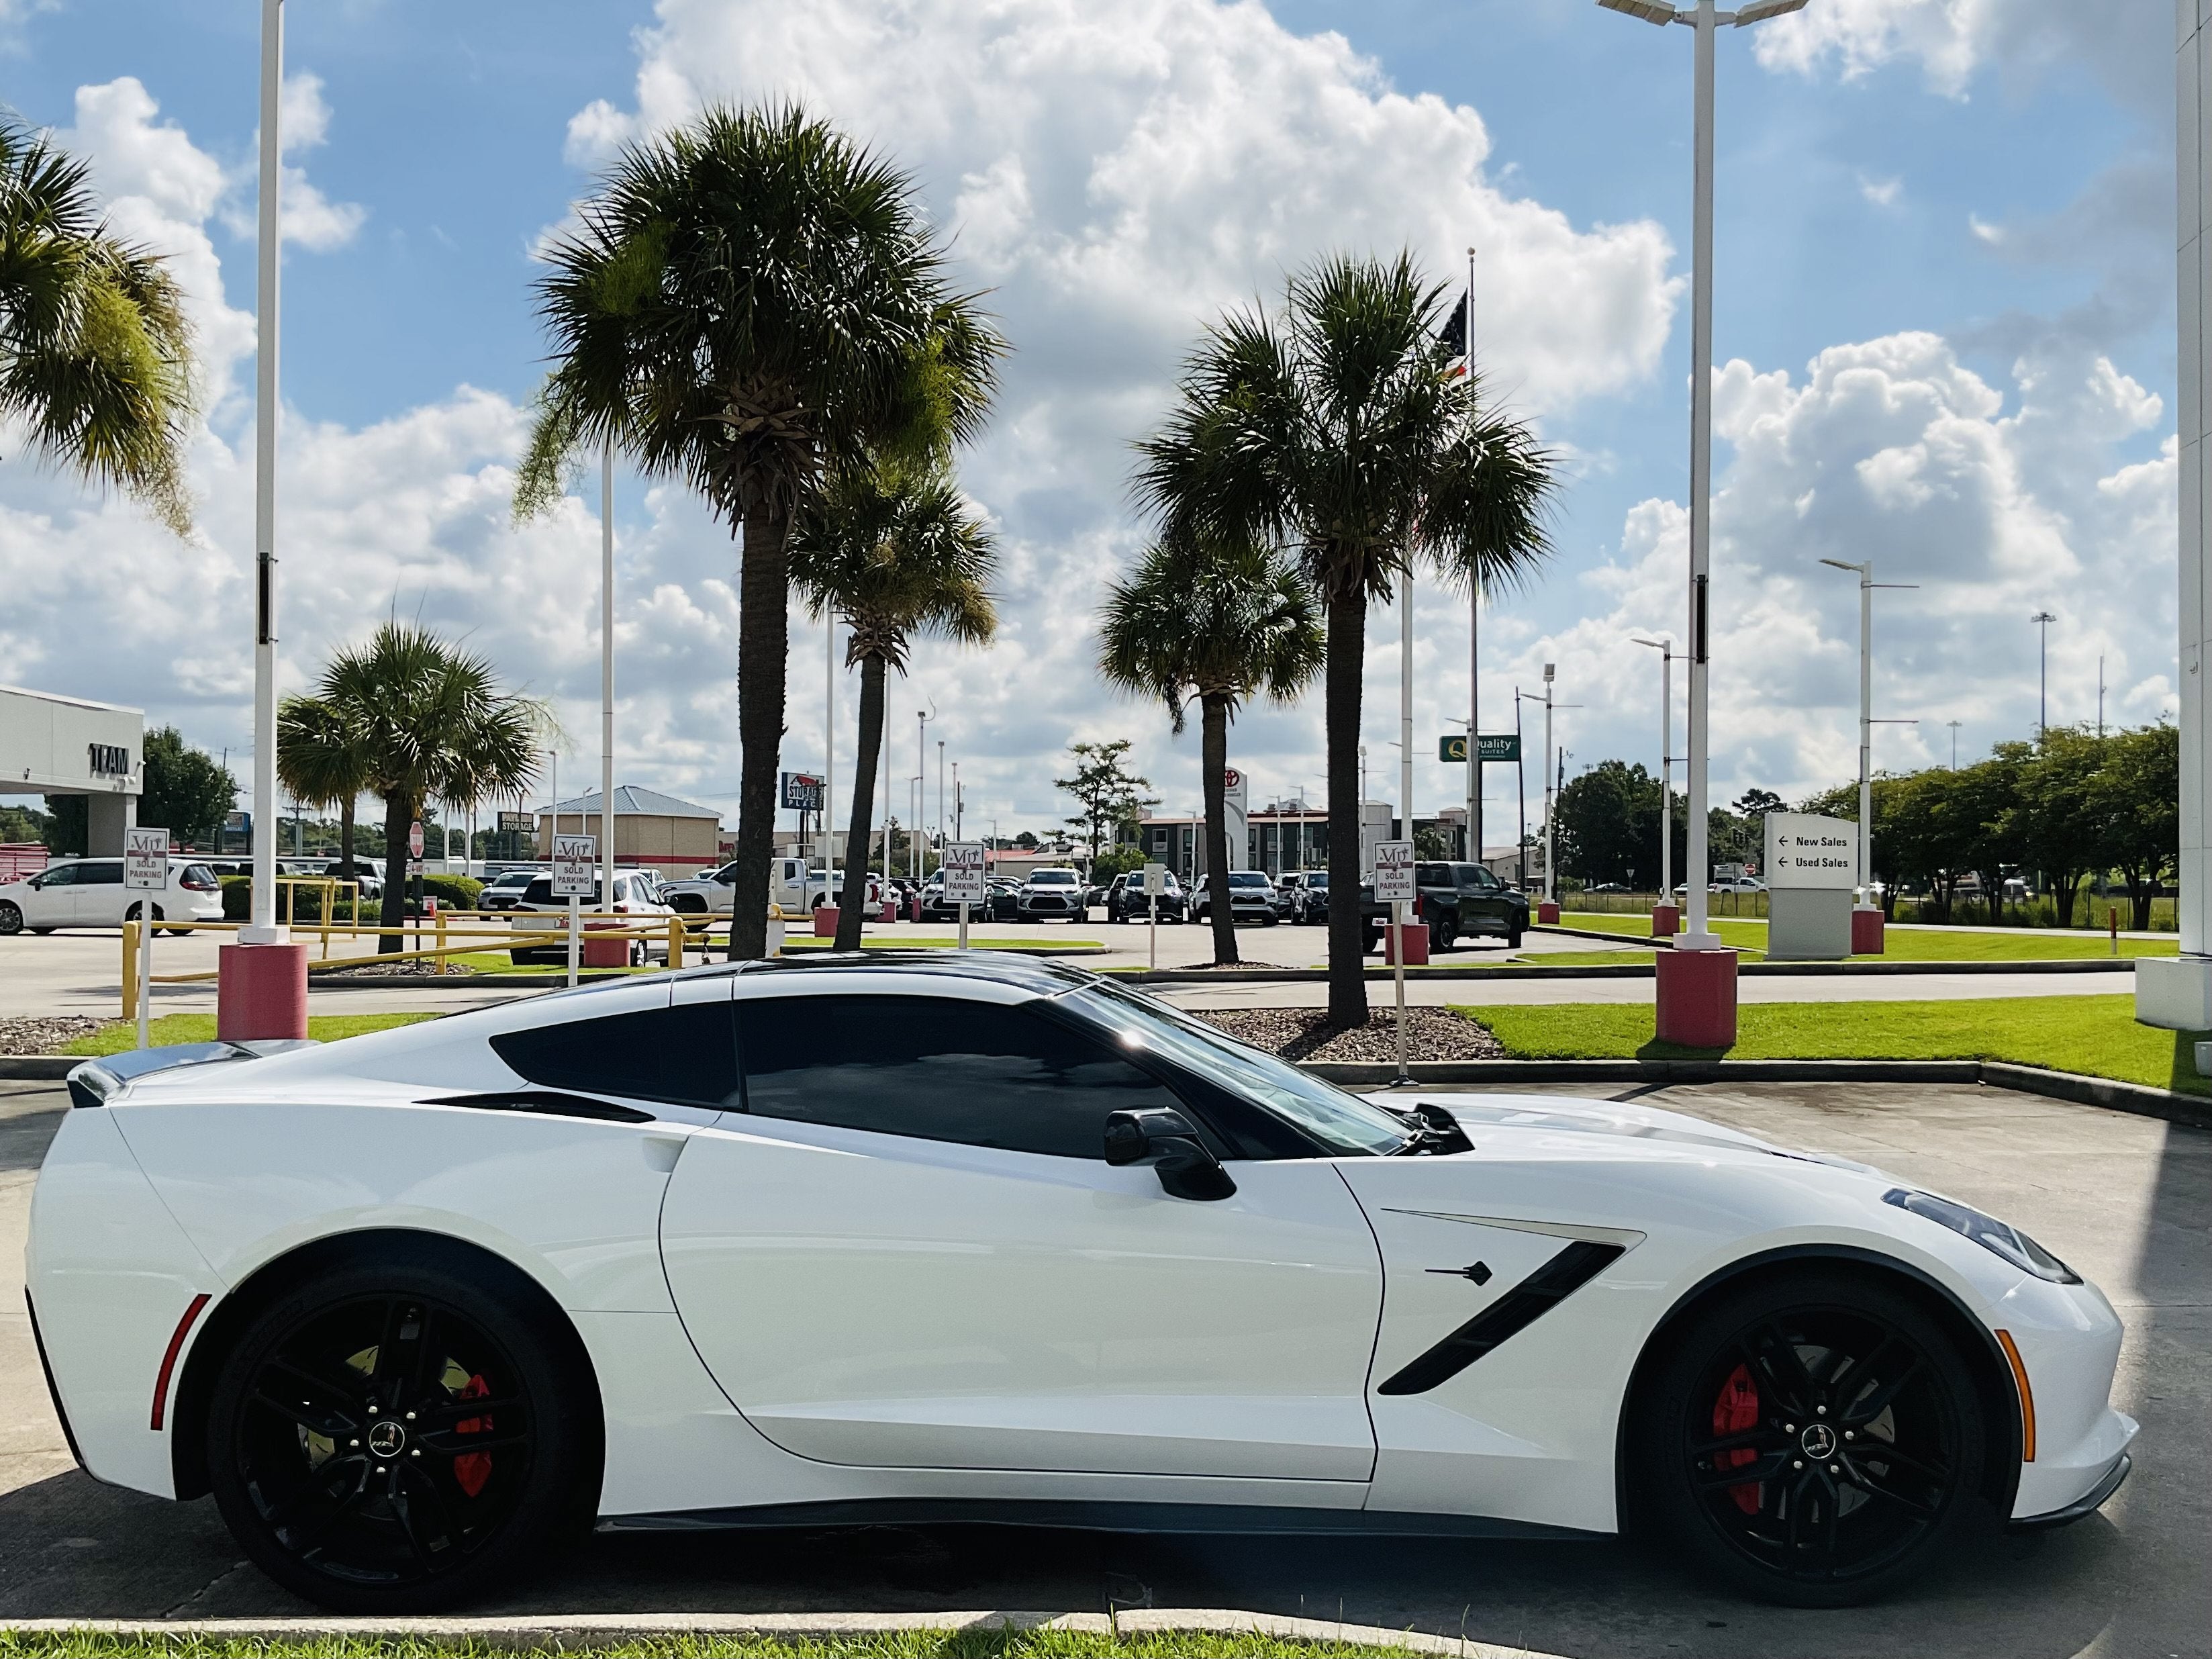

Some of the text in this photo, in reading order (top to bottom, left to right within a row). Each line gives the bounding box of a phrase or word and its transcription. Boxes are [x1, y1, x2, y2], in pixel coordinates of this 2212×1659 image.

[1477, 739, 1512, 751] uality
[89, 743, 129, 774] TEAM
[411, 833, 422, 846] STOP
[1796, 837, 1847, 847] New Sales
[136, 860, 156, 868] SOLD
[1796, 858, 1848, 867] Used Sales
[130, 870, 162, 878] PARKING
[557, 876, 589, 884] PARKING
[949, 882, 979, 890] PARKING
